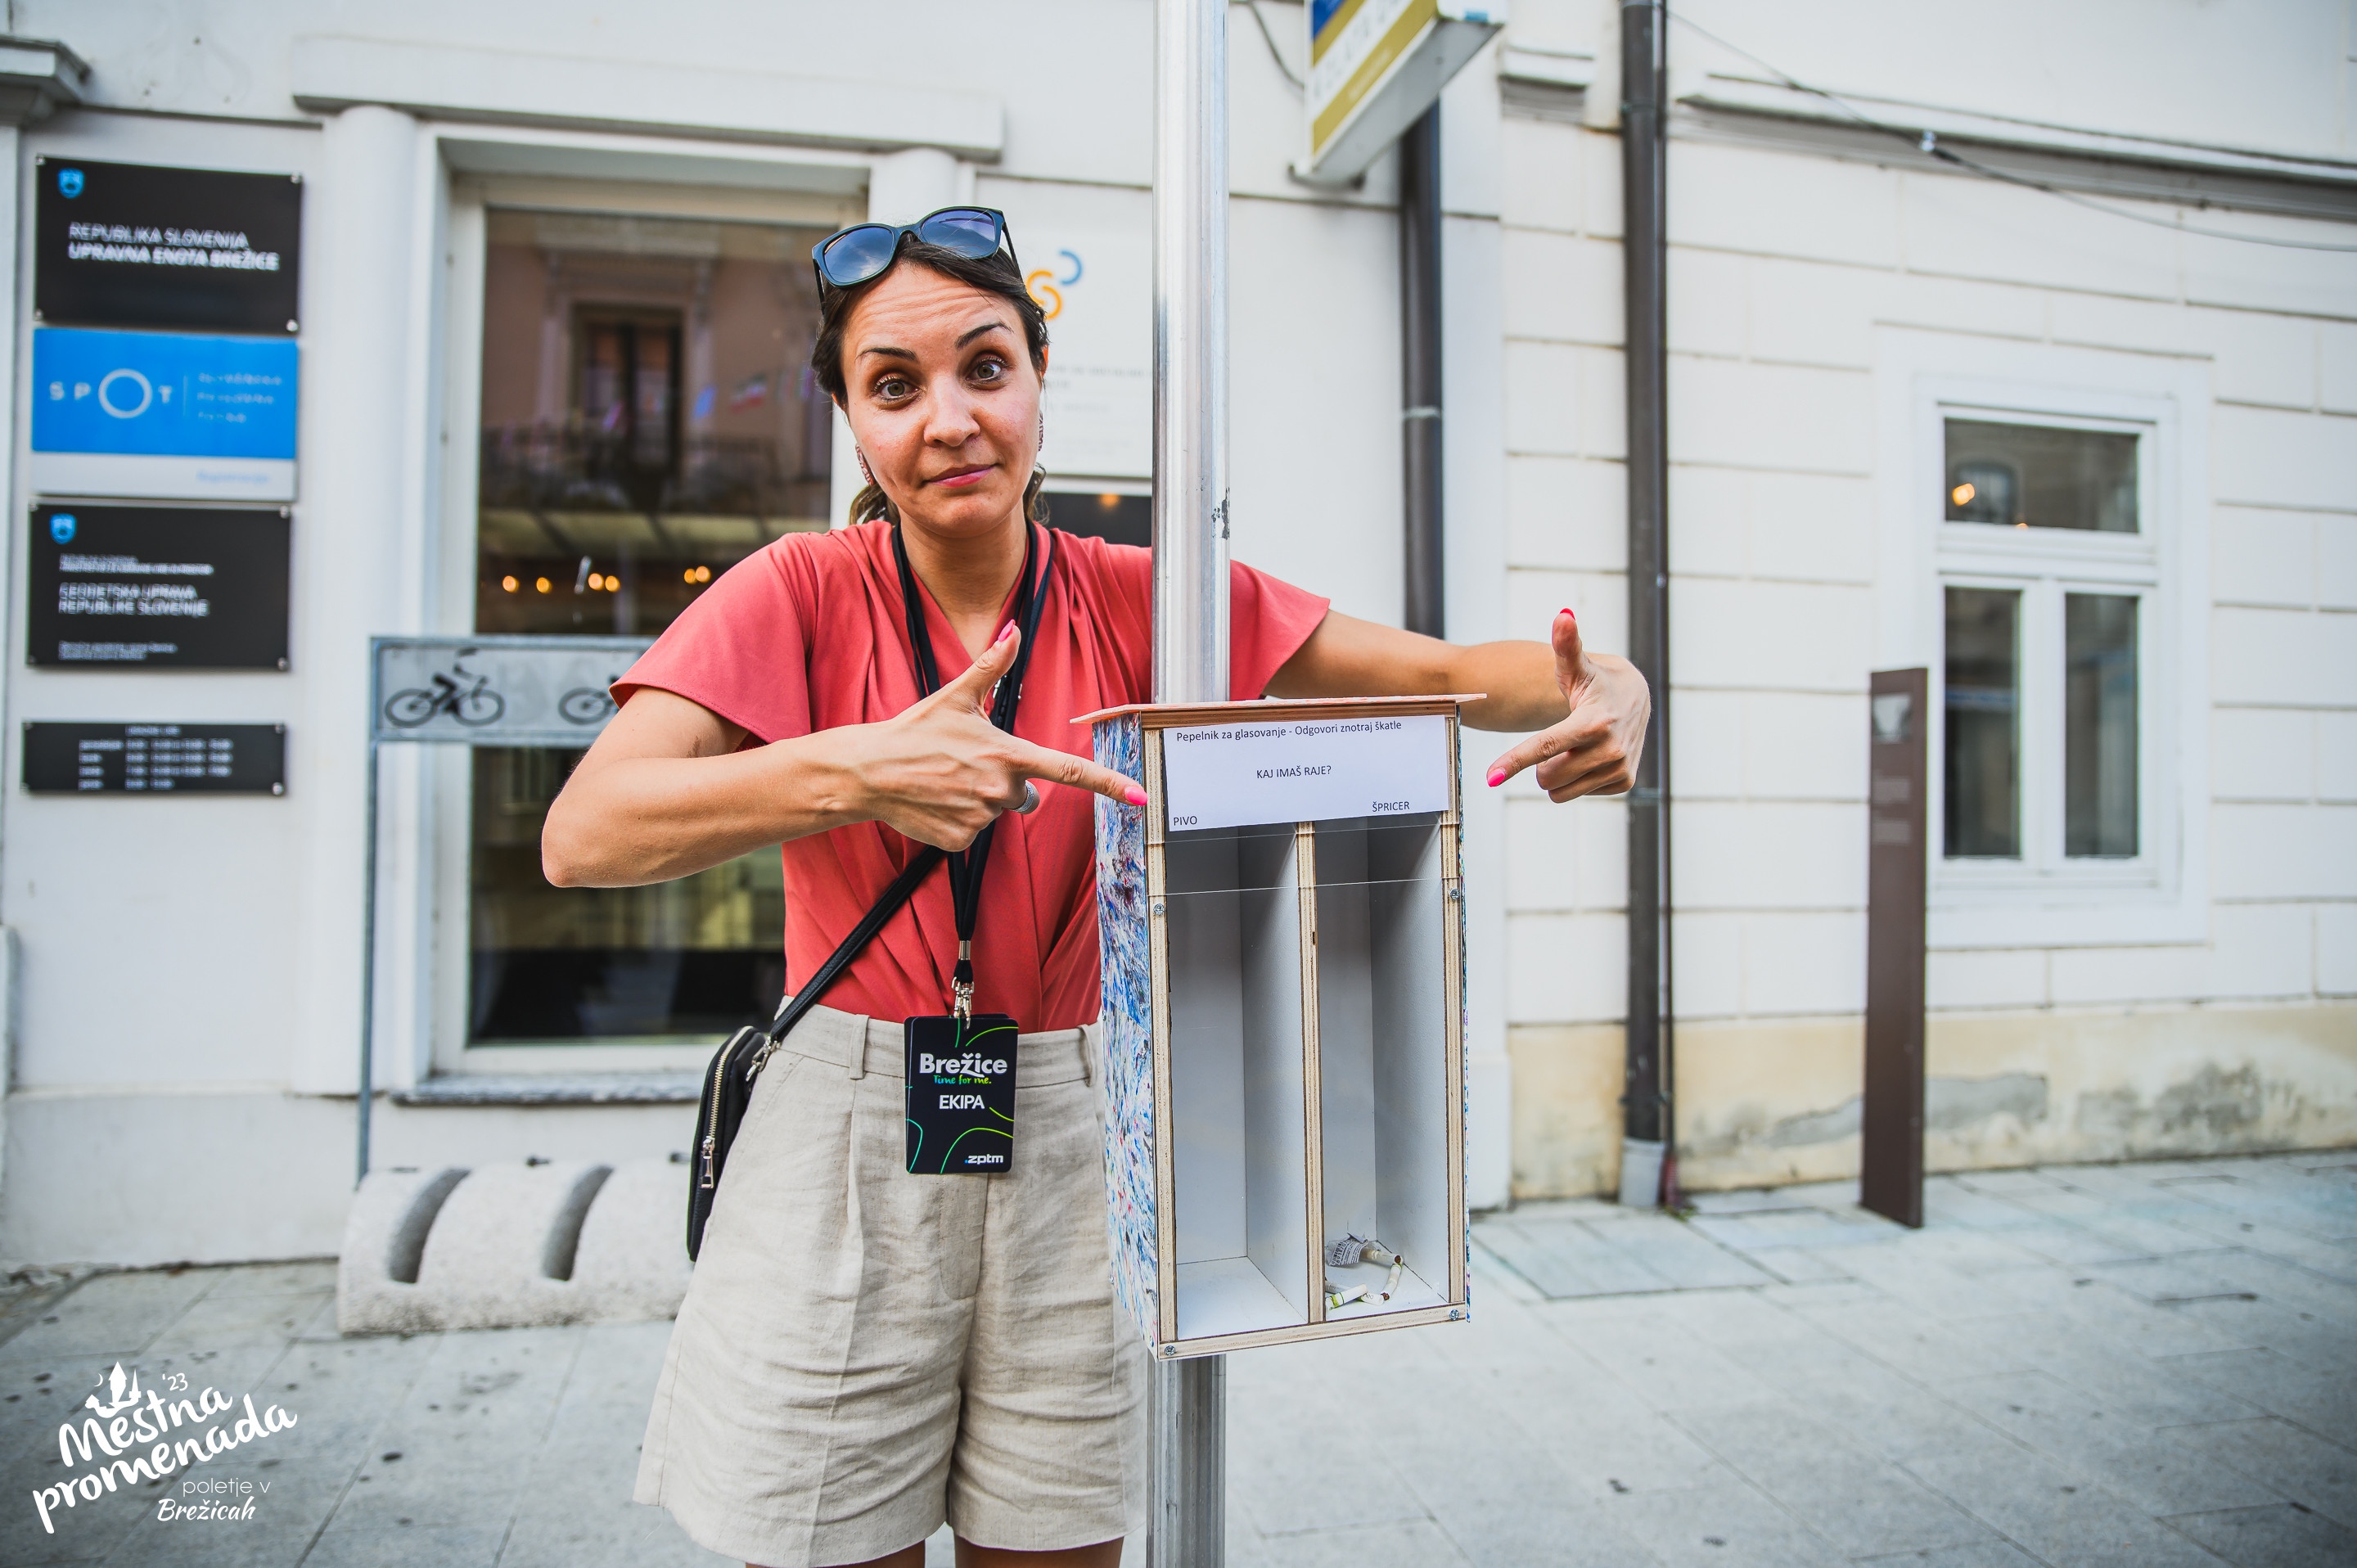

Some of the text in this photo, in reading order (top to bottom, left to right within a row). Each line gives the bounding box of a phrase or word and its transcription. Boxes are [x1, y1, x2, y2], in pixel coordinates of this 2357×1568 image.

[68, 221, 163, 245] REPUBLIKA
[67, 241, 281, 271] UPRAVNA ENOTA BREŽICE
[49, 367, 173, 419] SPOT
[1176, 731, 1219, 743] Pepelnik
[1222, 731, 1233, 739] za
[1235, 727, 1287, 741] glasovanje
[1295, 723, 1338, 737] Odgovori
[1341, 722, 1372, 733] znotraj
[1375, 720, 1402, 731] škatle
[1256, 764, 1332, 779] KAJ IMAŠ RAJE?
[1372, 800, 1410, 813] ŠPRICER
[1173, 816, 1197, 827] PIVO
[919, 1052, 1008, 1079] Brežice
[933, 1075, 956, 1084] Time
[958, 1074, 971, 1085] for
[939, 1094, 985, 1110] EKIPA
